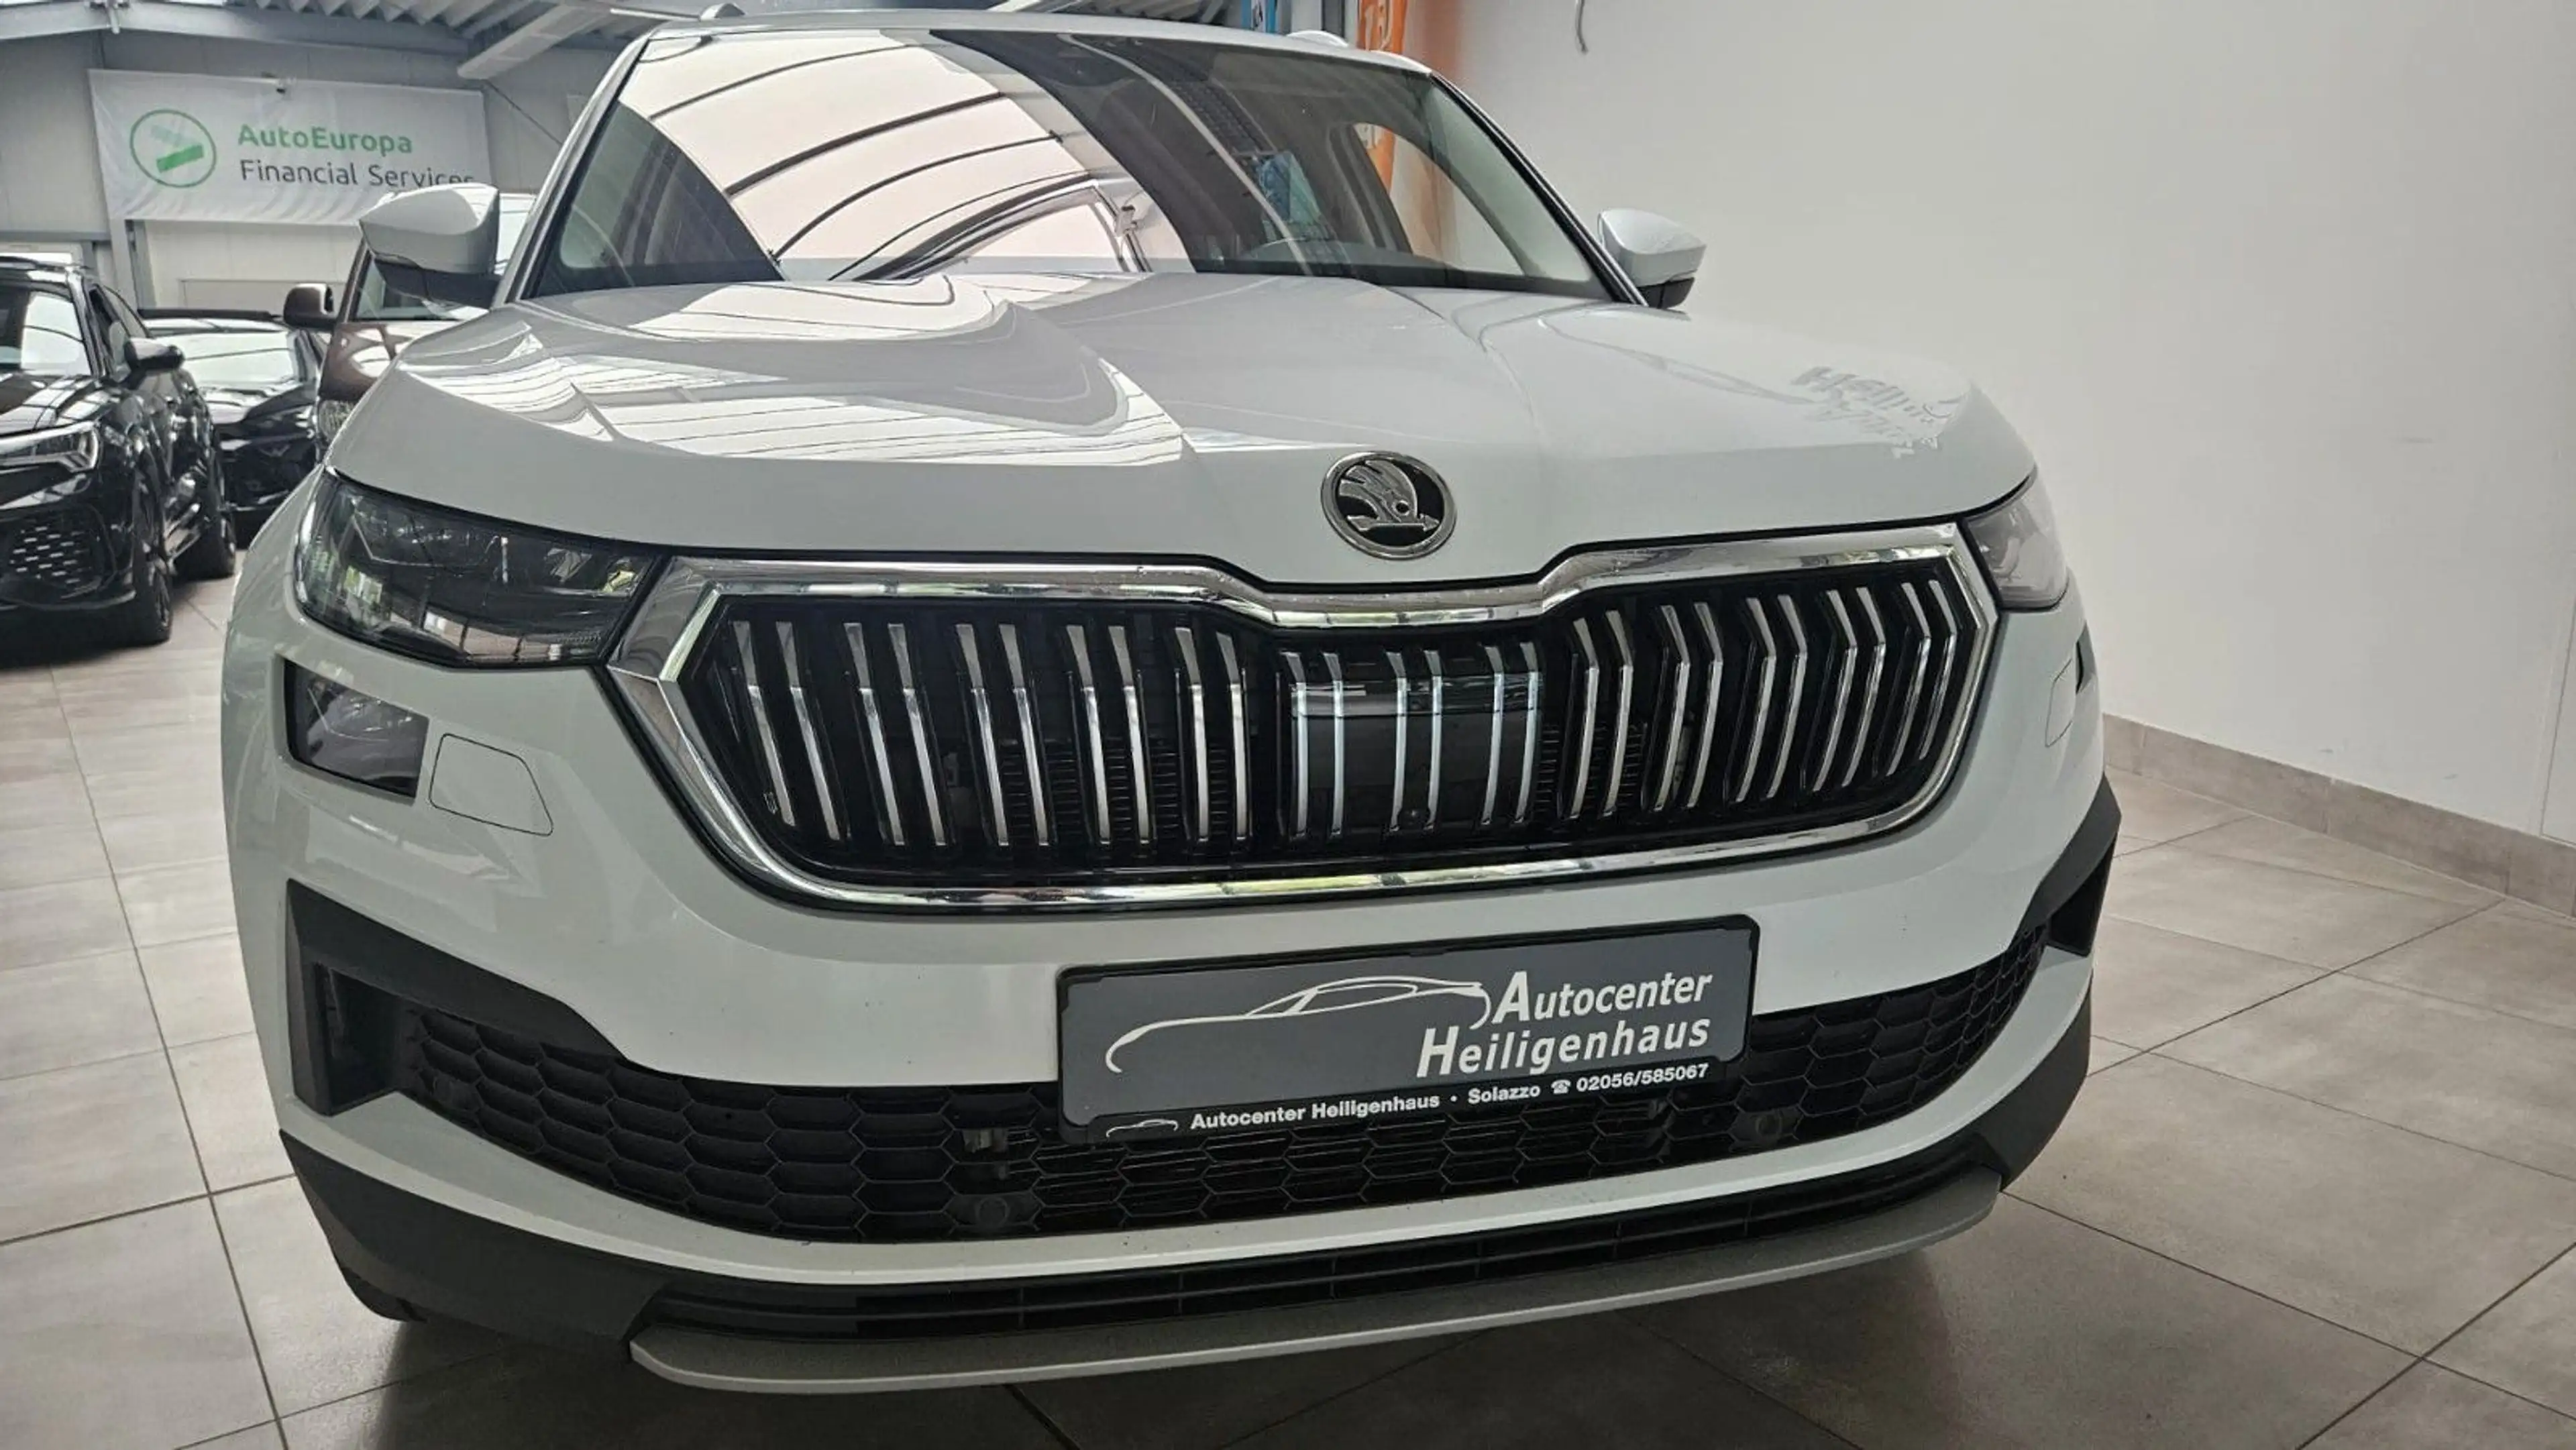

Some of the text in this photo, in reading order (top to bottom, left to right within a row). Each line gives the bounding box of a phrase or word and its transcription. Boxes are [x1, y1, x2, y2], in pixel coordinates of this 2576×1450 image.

[237, 123, 413, 157] AutoEuropa
[240, 159, 358, 186] Financial
[1491, 970, 1713, 1024] Autocenter
[1416, 1018, 1711, 1078] Heiligenhaus
[1190, 1063, 1709, 1130] Autocenter Heiligenhaus Solazzo 02056/585067
